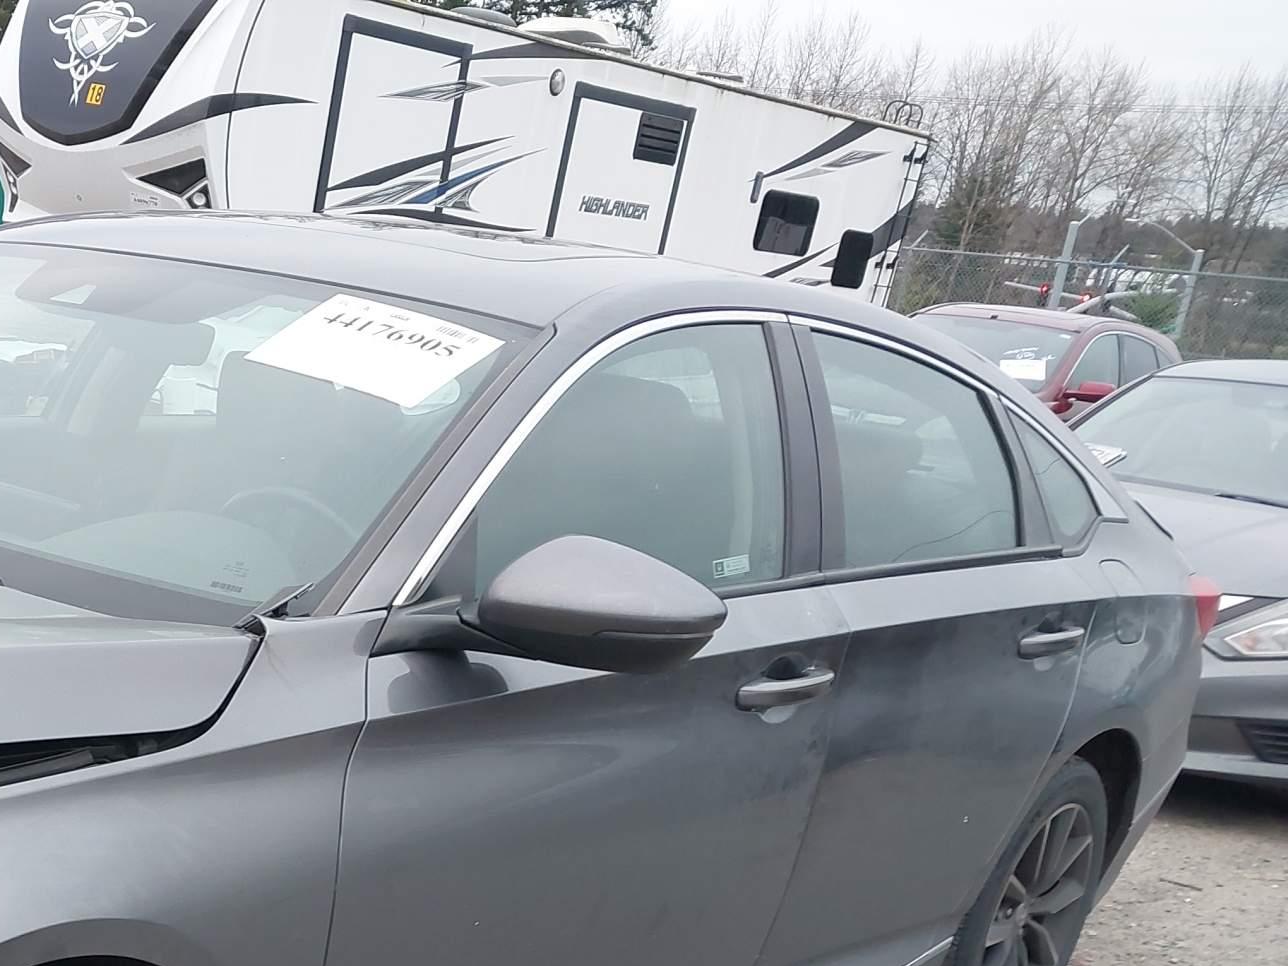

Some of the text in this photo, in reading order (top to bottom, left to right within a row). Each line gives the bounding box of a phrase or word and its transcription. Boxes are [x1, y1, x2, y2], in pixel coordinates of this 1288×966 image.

[89, 84, 104, 103] 18
[578, 195, 650, 221] HIGHLANDER
[323, 312, 461, 358] 44176905
